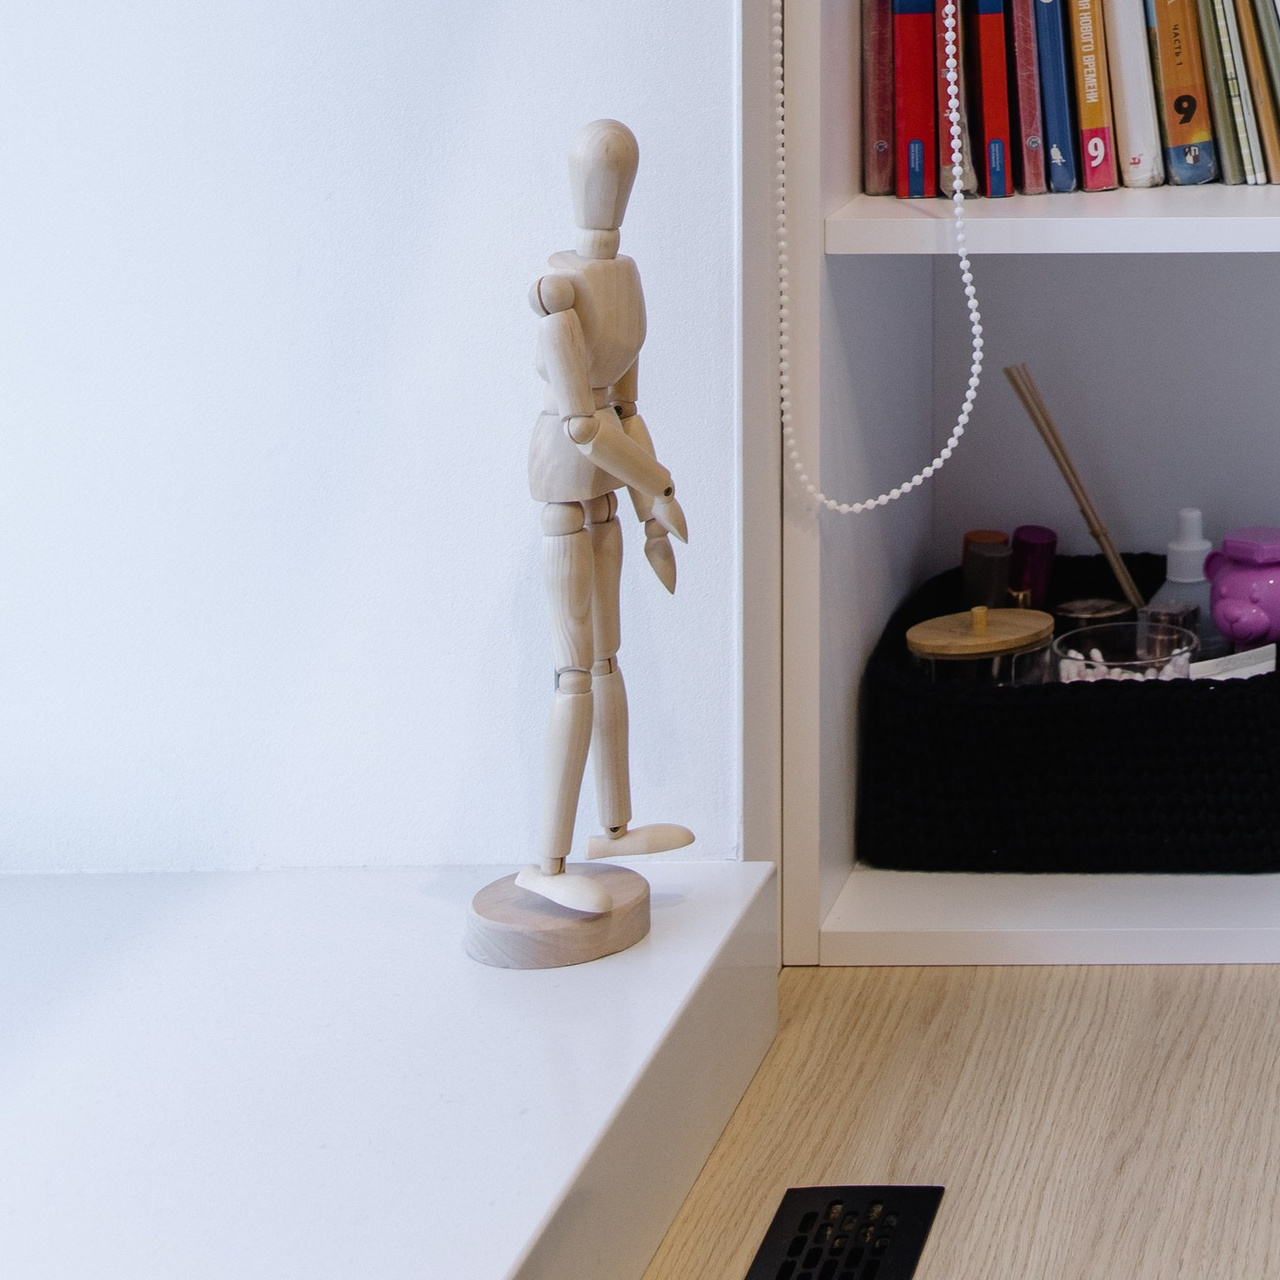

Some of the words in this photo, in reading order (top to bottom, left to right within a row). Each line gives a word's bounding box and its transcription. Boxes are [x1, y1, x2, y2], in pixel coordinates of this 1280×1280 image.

[1077, 12, 1095, 53] НОВОГО
[1171, 23, 1181, 58] ЧАСТЬ
[1082, 54, 1099, 103] ВРЕМЕНИ
[1173, 93, 1198, 125] 9
[1088, 136, 1106, 168] 9
